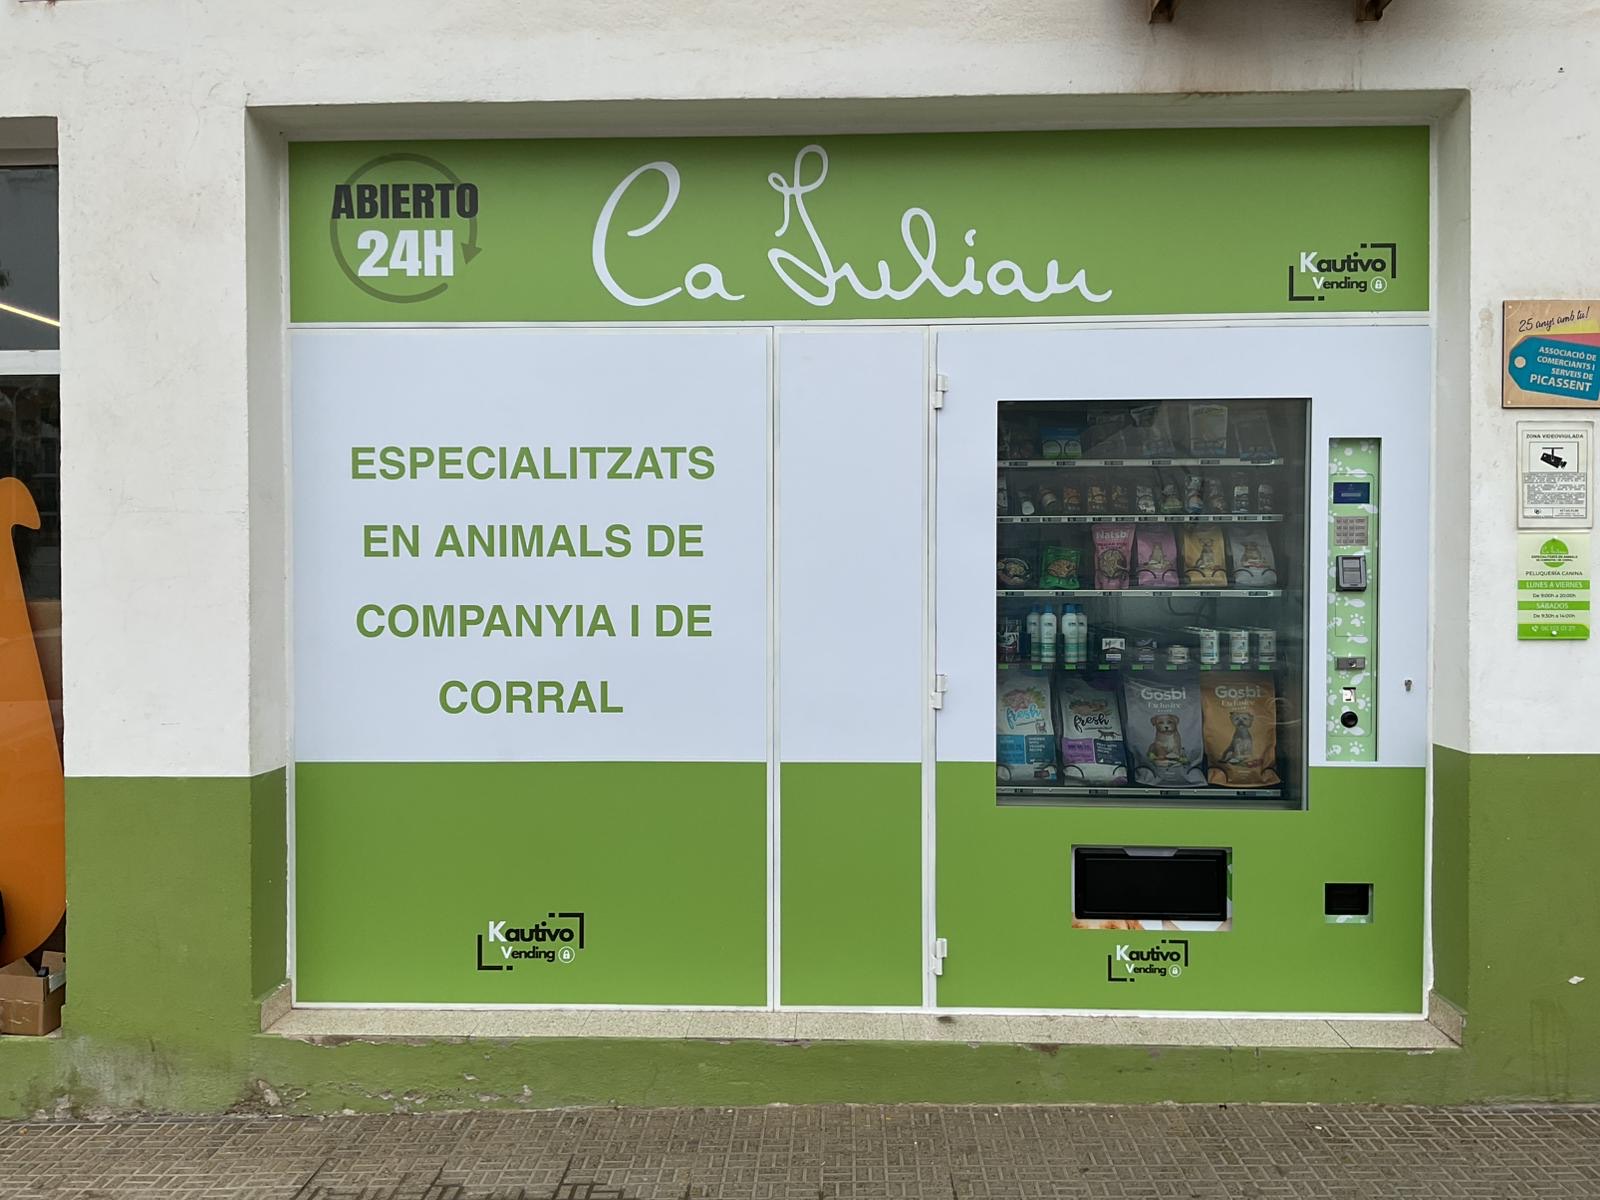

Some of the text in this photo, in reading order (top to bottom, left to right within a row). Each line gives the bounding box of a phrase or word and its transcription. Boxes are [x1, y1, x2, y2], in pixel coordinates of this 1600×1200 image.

[332, 183, 479, 219] ABIERTO
[591, 160, 745, 307] Ca
[356, 229, 454, 277] 24H
[1300, 251, 1387, 273] Kautivo
[1312, 276, 1368, 293] Vending
[1518, 318, 1534, 333] 25
[1556, 310, 1576, 325] amb
[1537, 356, 1591, 371] COMERCIANTS
[1539, 346, 1597, 362] ASSOCIACIÓ DE
[1529, 373, 1593, 392] PICASSENT
[1551, 367, 1594, 381] SERVEIS DE
[351, 446, 715, 480] ESPECIALITZATS
[363, 524, 705, 558] EN ANIMALS DE
[1526, 581, 1549, 589] LUNES
[356, 604, 713, 638] COMPANYIA I DE
[438, 680, 624, 714] CORRAL
[1140, 687, 1187, 701] Gosbi
[1214, 685, 1262, 699] Gosbi
[1073, 713, 1110, 733] fresh
[488, 920, 575, 943] Kautivo
[501, 945, 556, 963] Vending
[1116, 944, 1181, 962] Kautivo
[1125, 963, 1167, 977] Vending
